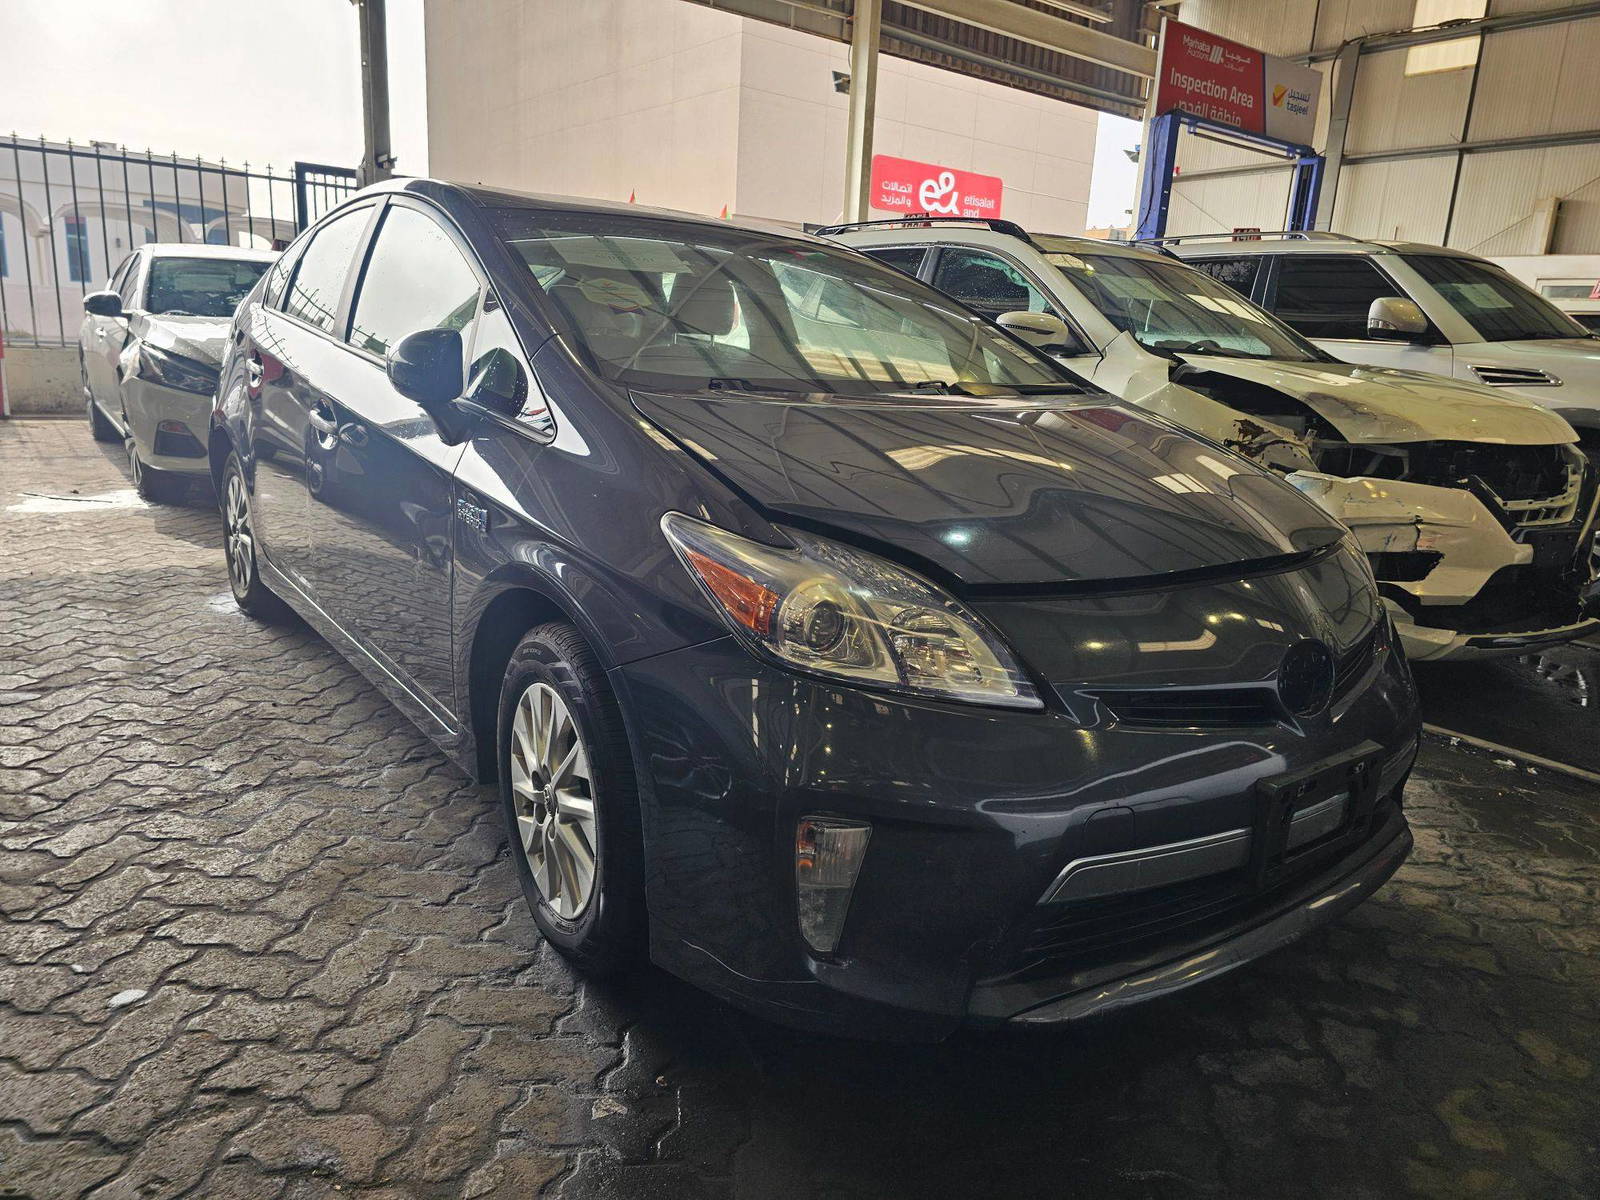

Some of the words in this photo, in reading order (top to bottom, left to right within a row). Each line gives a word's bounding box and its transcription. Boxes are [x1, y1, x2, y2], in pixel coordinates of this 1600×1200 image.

[1170, 67, 1227, 101] Inspection
[1228, 86, 1253, 108] Area
[1210, 106, 1241, 127] منطقة
[881, 180, 913, 193] اتصالات
[881, 193, 912, 208] والمزيد
[964, 195, 995, 209] etisalat
[963, 208, 979, 217] and
